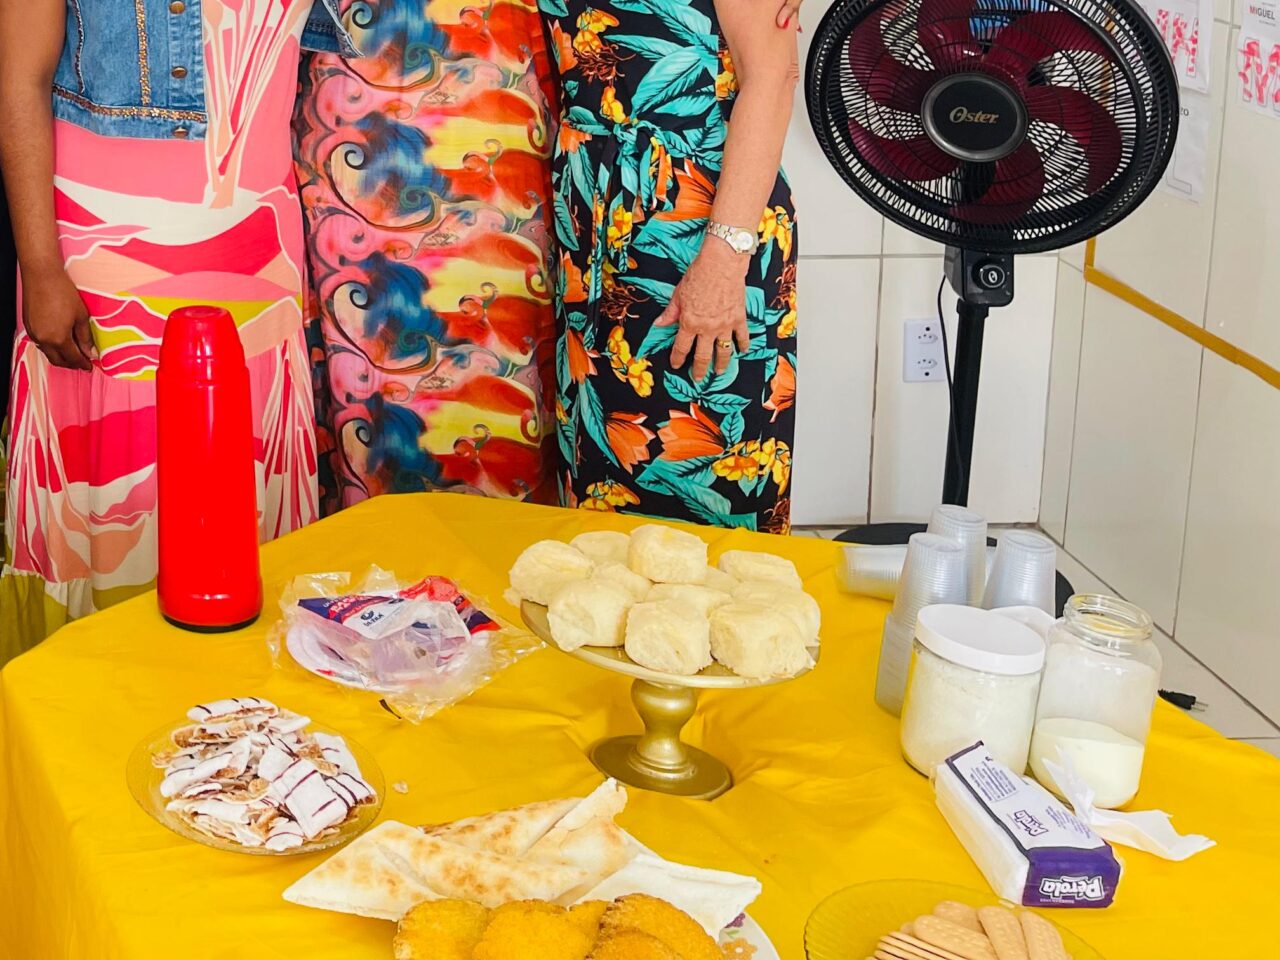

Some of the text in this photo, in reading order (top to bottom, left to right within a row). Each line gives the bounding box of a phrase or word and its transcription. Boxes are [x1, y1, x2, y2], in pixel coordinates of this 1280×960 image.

[1249, 5, 1276, 20] MIGUEL
[949, 106, 999, 124] Oster
[1014, 810, 1049, 837] Pérola
[1040, 877, 1104, 900] Pérola
